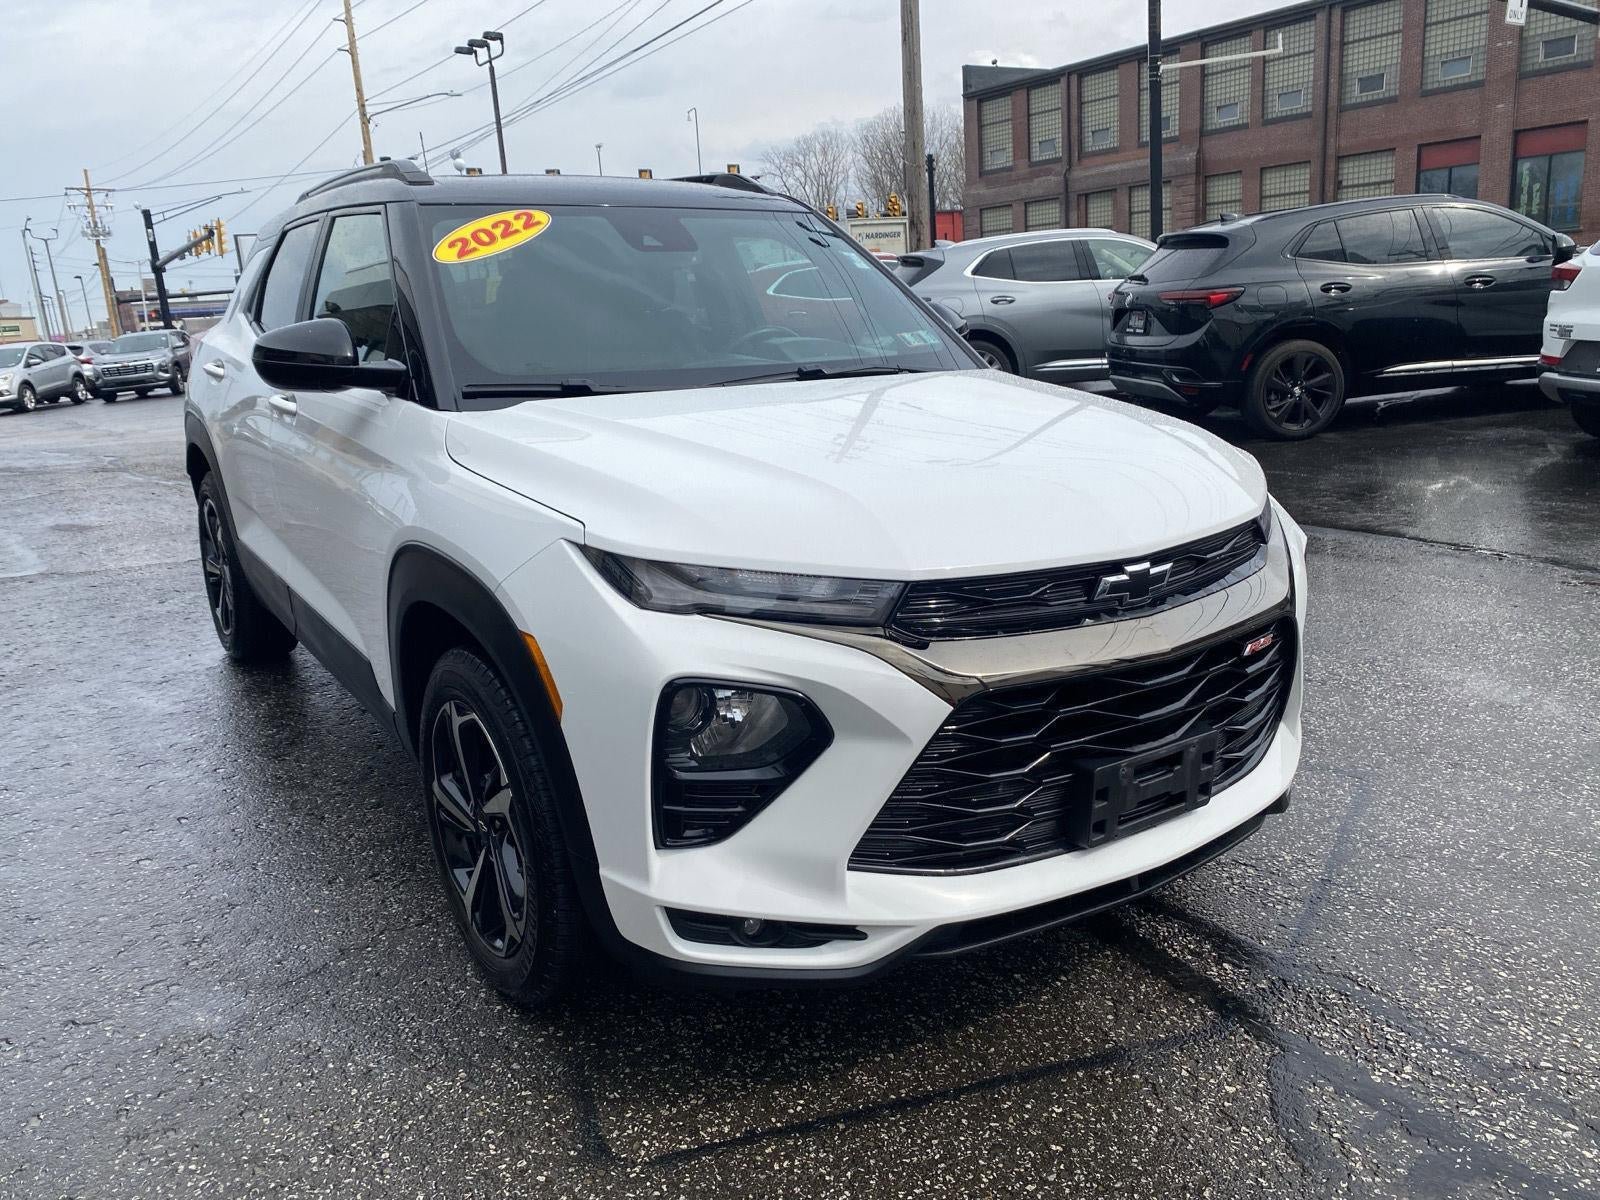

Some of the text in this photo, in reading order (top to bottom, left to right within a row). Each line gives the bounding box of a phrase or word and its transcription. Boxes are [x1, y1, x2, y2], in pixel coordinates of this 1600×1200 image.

[1508, 9, 1524, 20] ONLY
[447, 211, 545, 259] 2022
[865, 231, 902, 240] HARDINGER
[1243, 633, 1274, 656] RS
